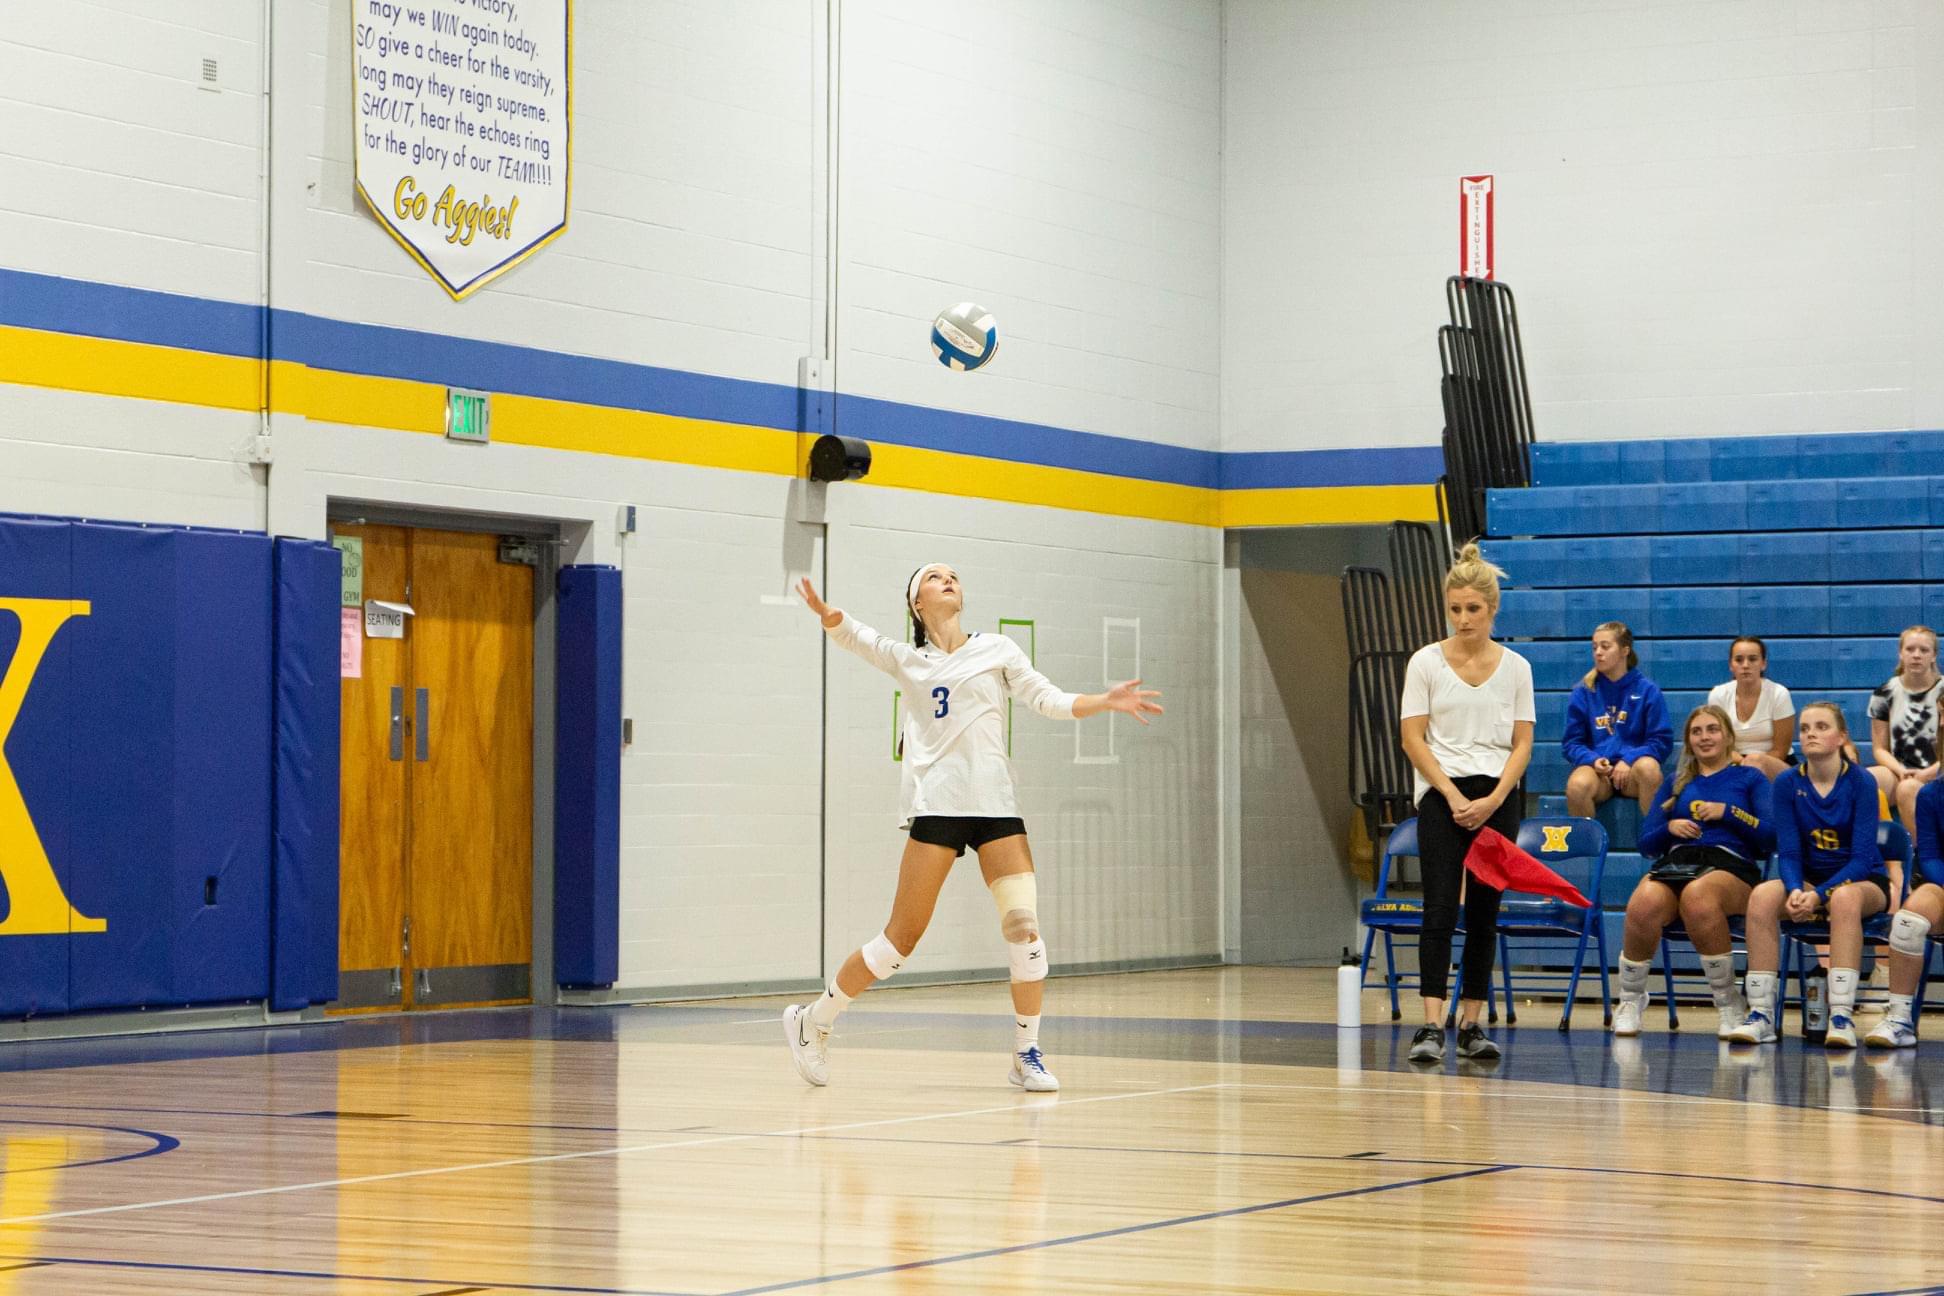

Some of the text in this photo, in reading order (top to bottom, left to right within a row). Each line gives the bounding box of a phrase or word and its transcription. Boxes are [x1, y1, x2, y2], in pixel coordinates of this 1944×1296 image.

[369, 1, 539, 61] may we WIN again today.
[356, 24, 555, 97] SO give a cheer for the varsity,
[359, 55, 550, 123] long may they reign supreme.
[362, 92, 550, 160] SHOUT, hear the echoes ring
[364, 123, 381, 149] for
[385, 130, 407, 156] the
[412, 136, 448, 170] glory
[453, 145, 467, 167] of
[470, 154, 492, 173] our
[393, 175, 520, 247] Go Aggies!
[453, 394, 486, 435] EXIT
[341, 566, 357, 578] OOD
[367, 612, 402, 627] SEATING
[932, 686, 950, 719] 3
